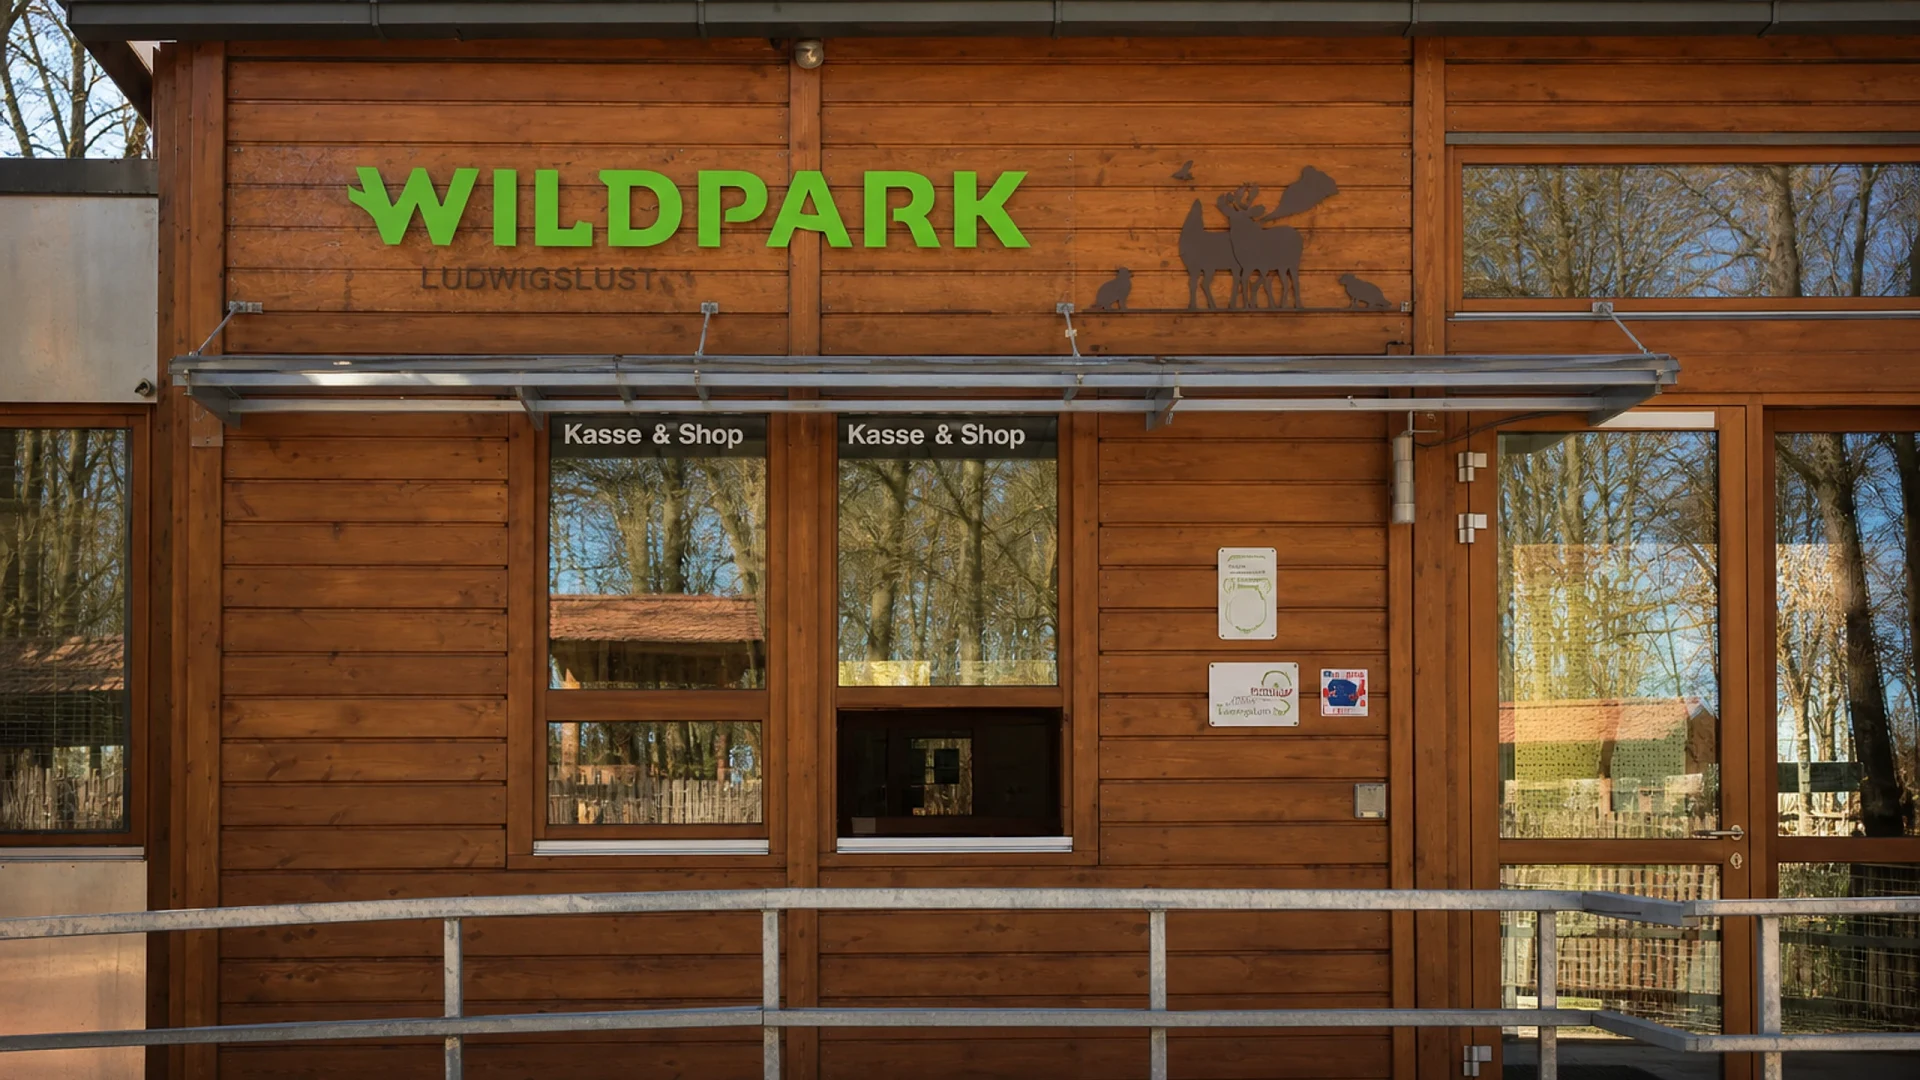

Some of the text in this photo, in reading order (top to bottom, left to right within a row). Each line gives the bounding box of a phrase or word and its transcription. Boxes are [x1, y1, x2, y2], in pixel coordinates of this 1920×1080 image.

[348, 167, 1031, 249] WILDPARK
[421, 266, 658, 291] LUDWIGSLUST
[564, 423, 744, 450] Kasse & Shop
[847, 423, 1026, 450] Kasse & Shop
